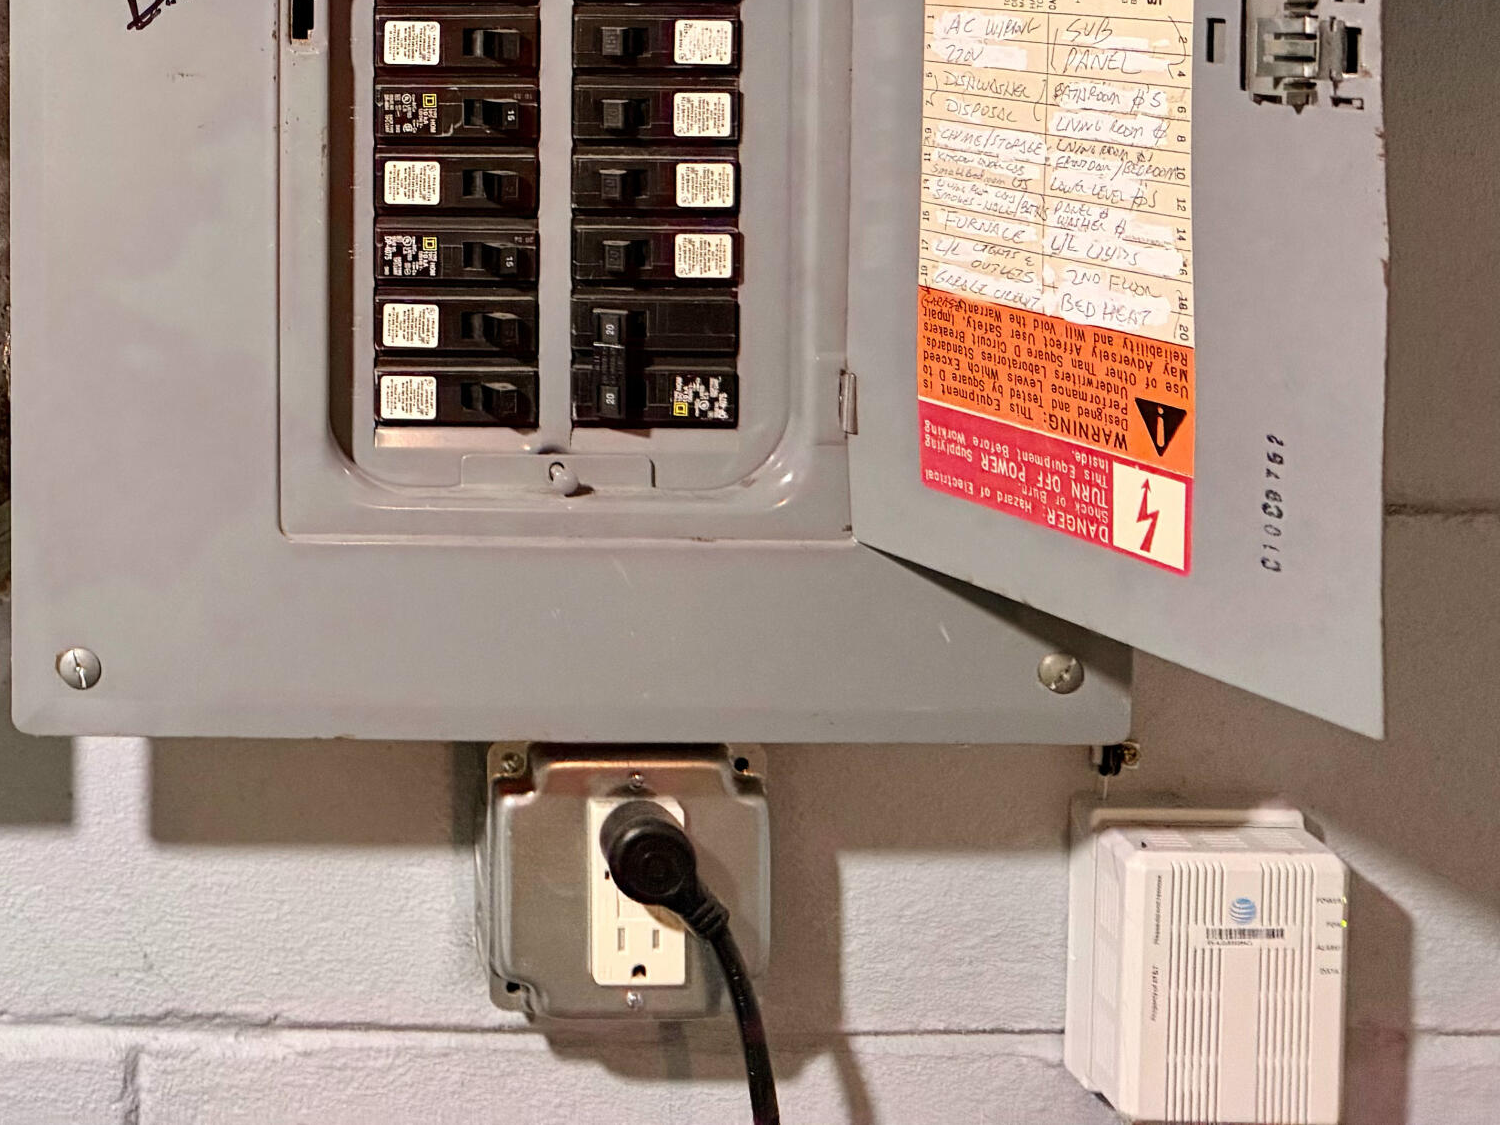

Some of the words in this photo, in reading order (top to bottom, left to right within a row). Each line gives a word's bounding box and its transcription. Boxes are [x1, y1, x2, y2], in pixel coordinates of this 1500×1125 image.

[1066, 16, 1112, 45] SUB
[1063, 47, 1142, 74] PANEL
[508, 110, 515, 121] 15
[946, 98, 1017, 122] DISPOSAL
[941, 209, 1025, 243] FURNACE
[506, 257, 514, 267] 15
[1061, 293, 1095, 317] BED
[1104, 298, 1151, 325] HEAT
[606, 324, 614, 335] 20
[922, 335, 974, 359] Standards.
[981, 352, 1046, 378] Laboratories
[1054, 370, 1128, 399] Underwriters
[606, 394, 615, 404] 20
[1042, 412, 1128, 451] WARNING:
[925, 435, 973, 462] Supplying
[1071, 450, 1109, 472] Inside.
[980, 453, 1026, 483] POWER
[925, 470, 974, 496] Electrical
[1037, 470, 1060, 492] OFF
[979, 488, 990, 500] of
[997, 491, 1032, 514] Hazard
[1071, 482, 1108, 507] TURN
[1042, 506, 1109, 543] DANGER:
